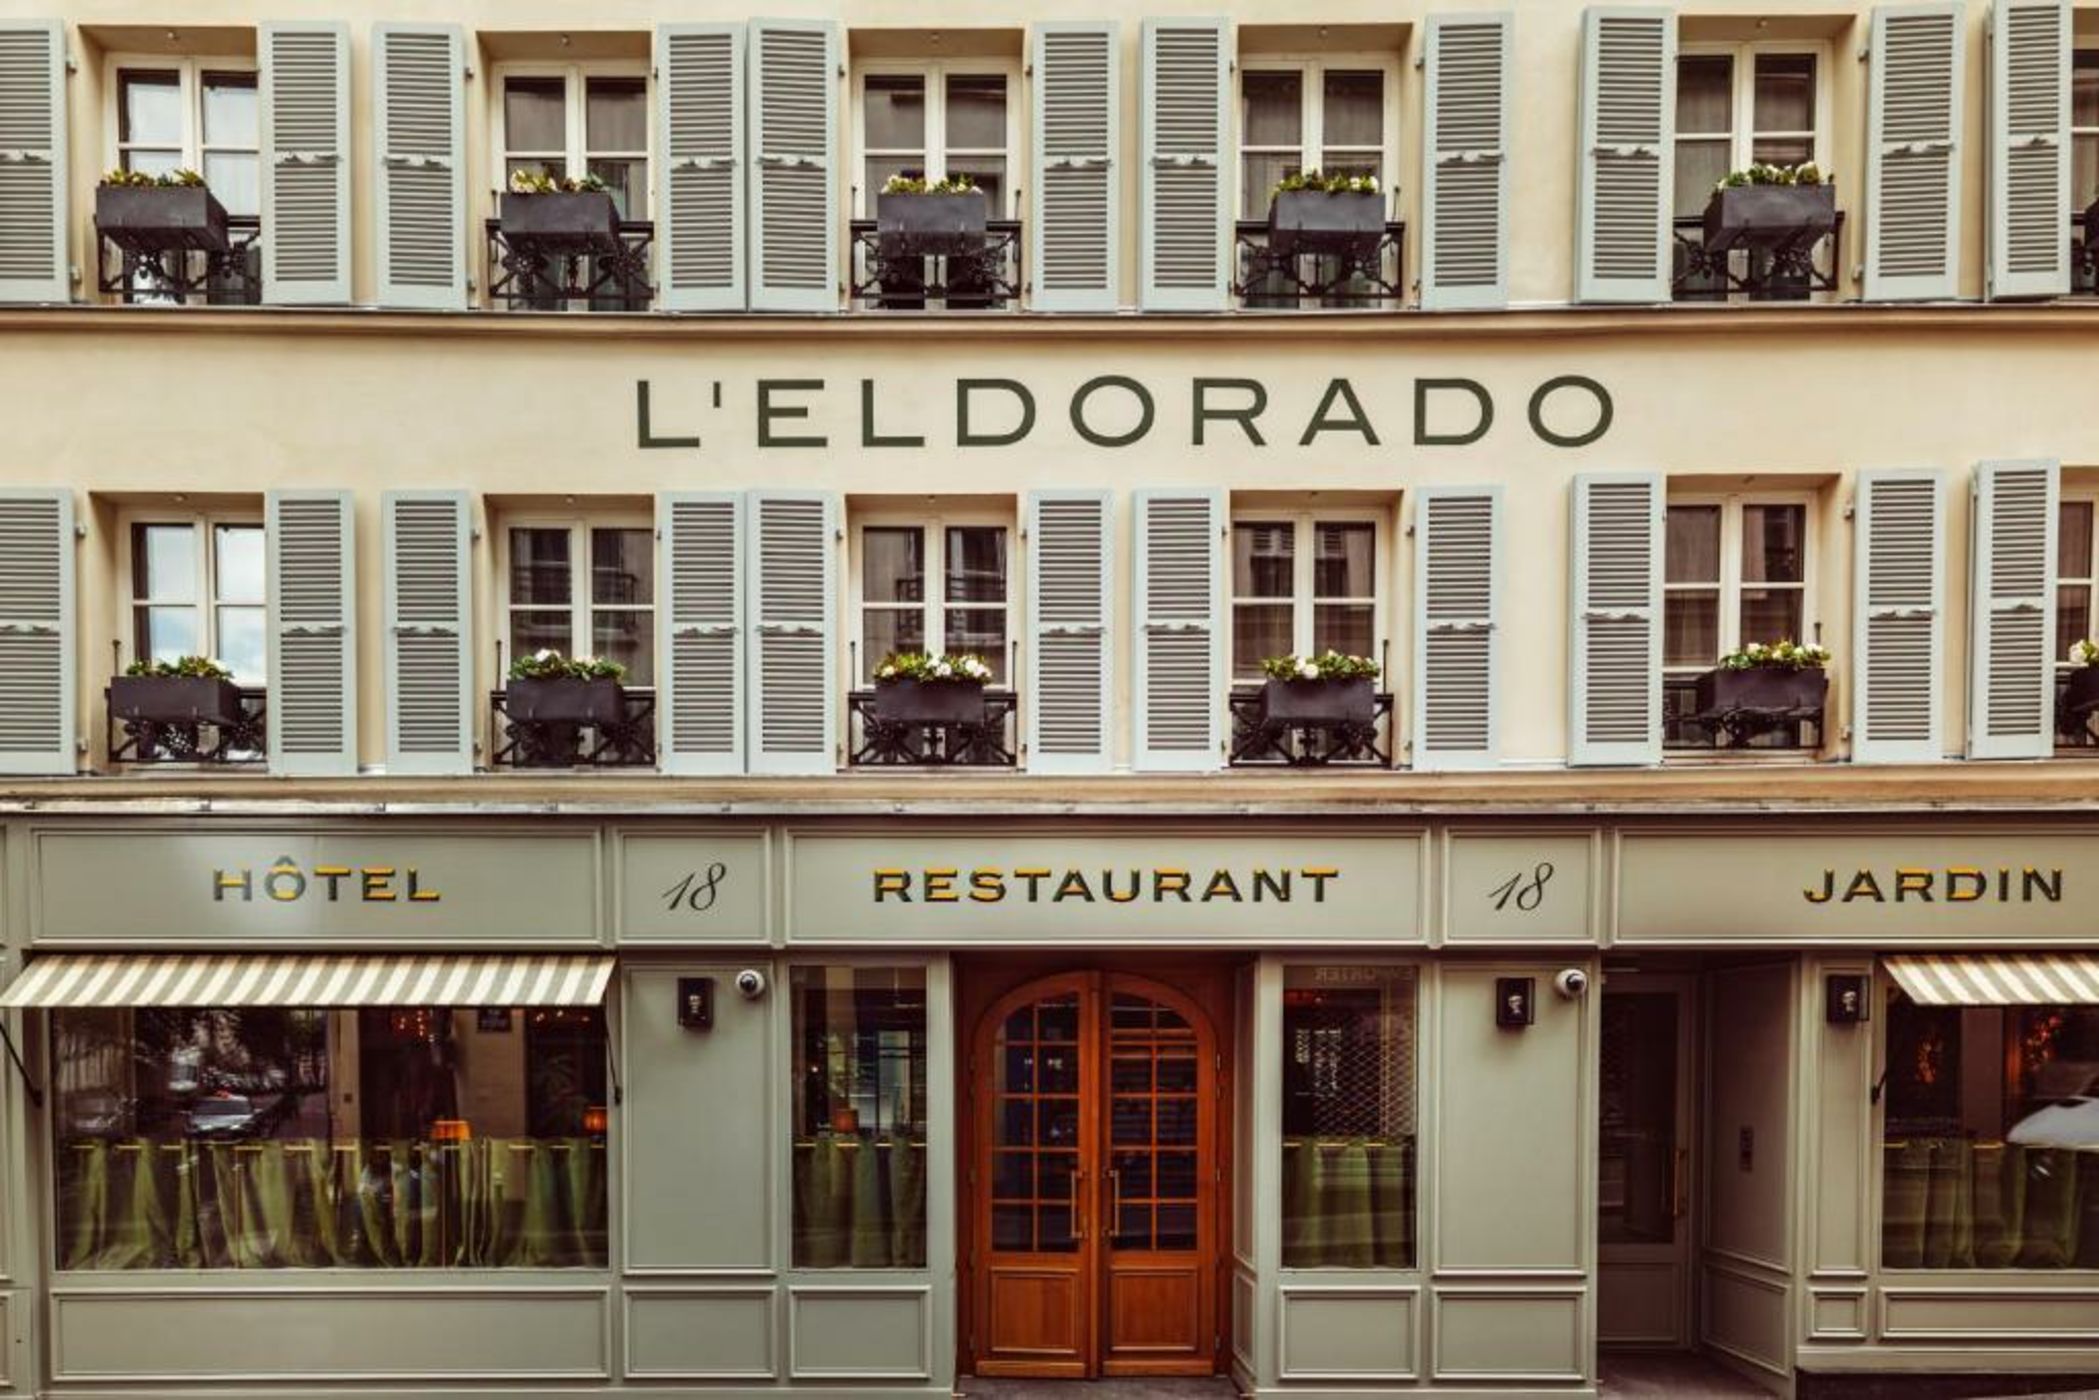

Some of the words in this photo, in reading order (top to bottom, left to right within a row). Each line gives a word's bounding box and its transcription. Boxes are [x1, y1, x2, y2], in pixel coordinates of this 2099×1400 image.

[637, 375, 1614, 449] L'ELDORADO
[214, 855, 440, 903] HÔTEL
[661, 862, 727, 912] 18
[874, 868, 1340, 904] RESTAURANT
[1488, 862, 1555, 912] 18
[1803, 868, 2063, 904] JARDIN
